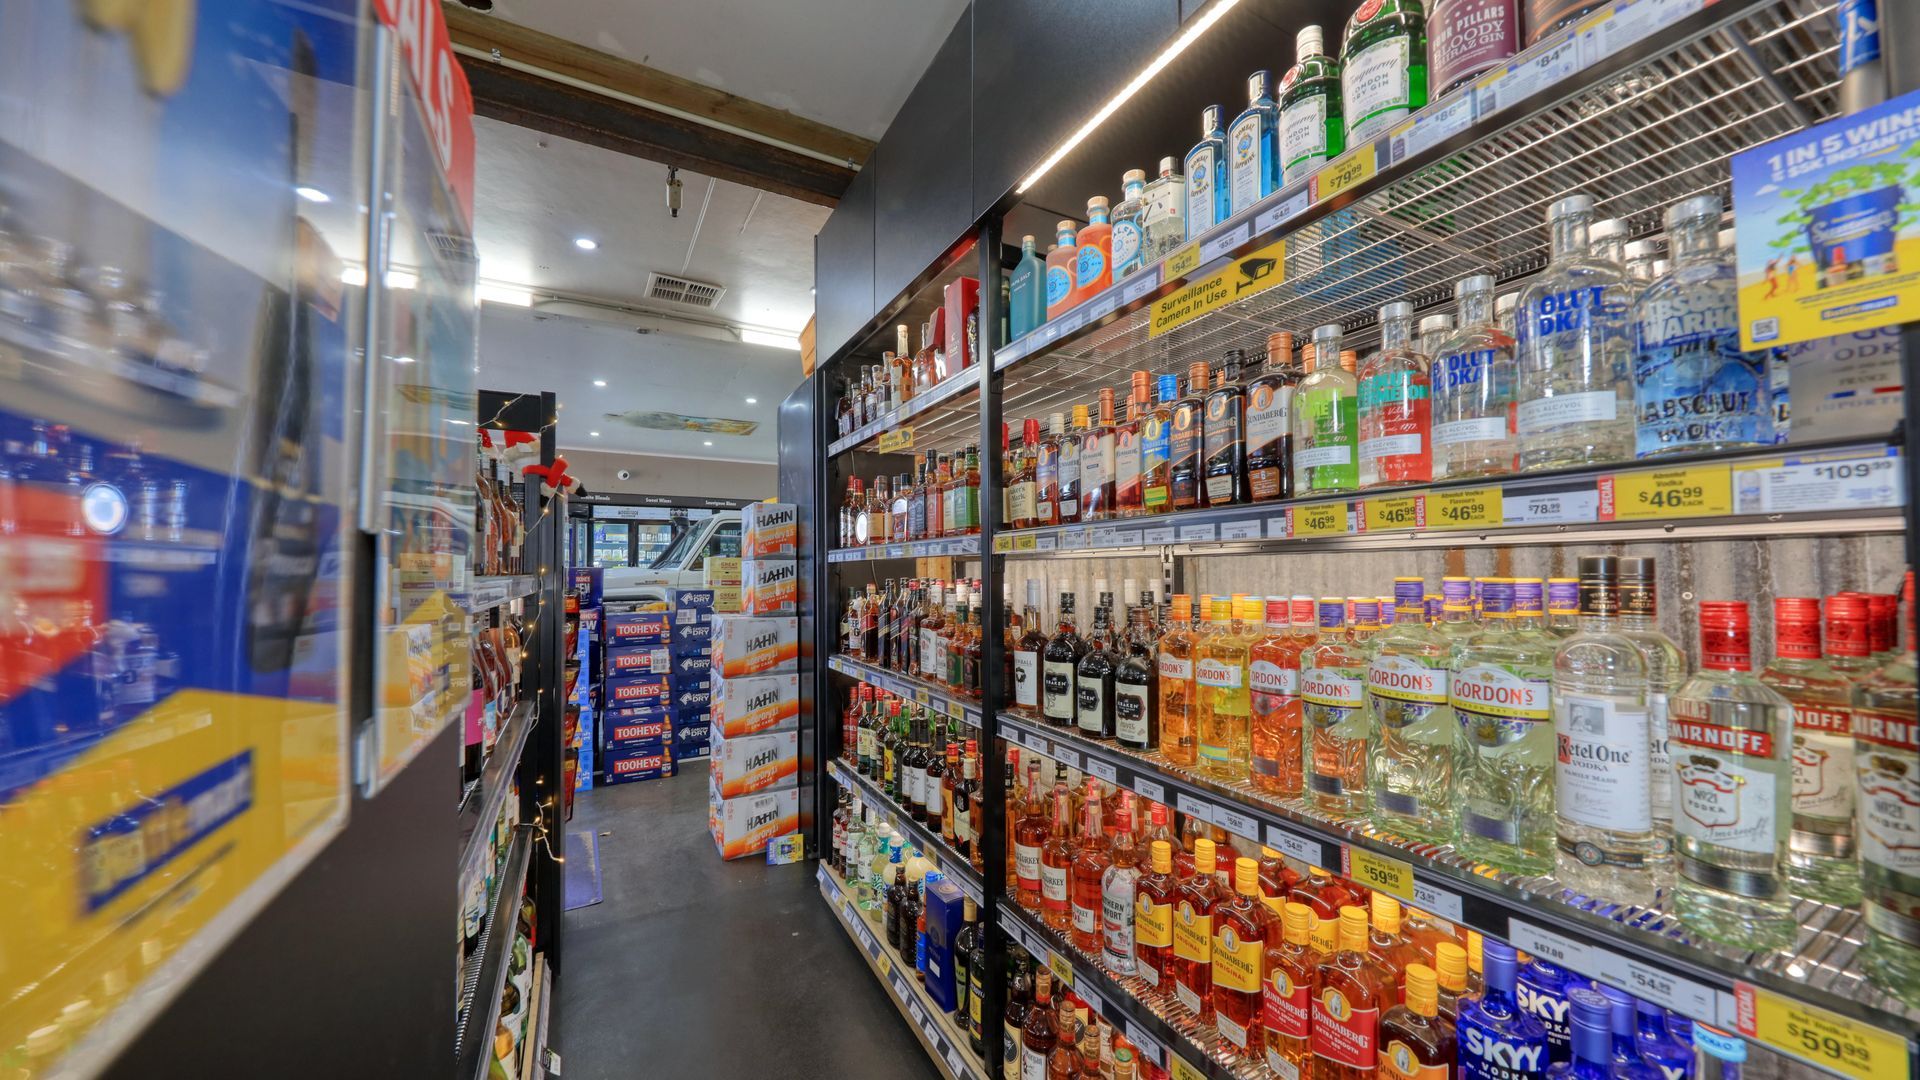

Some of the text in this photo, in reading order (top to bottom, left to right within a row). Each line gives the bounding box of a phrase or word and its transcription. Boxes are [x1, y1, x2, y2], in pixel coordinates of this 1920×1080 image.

[1457, 5, 1505, 32] PILLARS
[1434, 20, 1505, 61] BLOODY
[1479, 31, 1505, 45] GIN
[1767, 153, 1782, 173] 1
[1786, 141, 1818, 166] IN
[1821, 133, 1844, 156] 5
[1161, 275, 1223, 314] Surveillance
[1156, 287, 1229, 329] Camera In Use
[1440, 489, 1485, 499] Absolut Vodka
[1656, 478, 1684, 488] Vodka
[1601, 478, 1614, 515] SPECIAL
[756, 510, 794, 528] HAHN
[1286, 509, 1294, 537] SPECIAL
[1357, 502, 1365, 529] SPECIAL
[1416, 497, 1425, 527] SPECIAL
[757, 564, 794, 585] HAHN
[579, 620, 597, 631] EW
[618, 624, 660, 635] TOOHEYS
[746, 631, 778, 654] HAHN
[618, 656, 651, 666] TOOHE
[617, 685, 660, 697] TOOHEYS
[1302, 678, 1351, 698] GORDON'S
[1368, 667, 1433, 690] GORDON'S
[746, 689, 780, 712] HAHN
[1454, 679, 1535, 706] GORDON'S
[616, 724, 662, 738] TOOHEYS
[745, 747, 778, 772] HAHN
[1556, 732, 1594, 764] Ketel
[1596, 744, 1631, 764] One
[616, 758, 661, 770] TOOHEYS
[1571, 759, 1610, 773] VODKA
[746, 804, 780, 832] HAHN
[1358, 855, 1377, 866] London
[1213, 943, 1254, 975] BUNDABERG
[1214, 960, 1248, 983] ORIGINAL
[1263, 986, 1309, 1021] BUNDABERG
[1266, 1001, 1302, 1028] EXTRA SMOOTH
[1516, 982, 1571, 1023] SKY
[1312, 1004, 1370, 1050] BUNDABERG
[1315, 1024, 1360, 1056] EXTRA SMOOTH
[1465, 1026, 1543, 1072] SKYY
